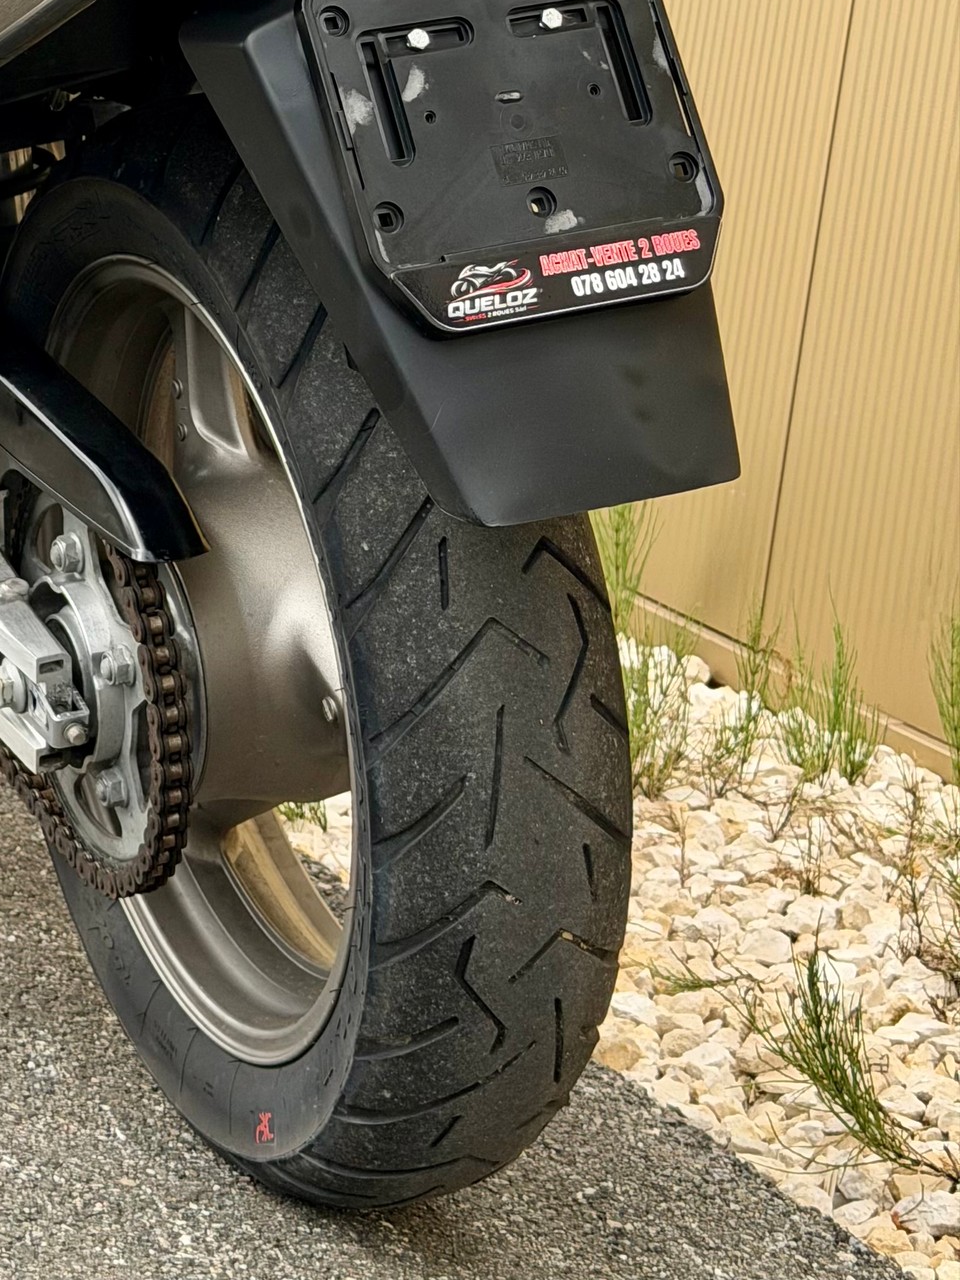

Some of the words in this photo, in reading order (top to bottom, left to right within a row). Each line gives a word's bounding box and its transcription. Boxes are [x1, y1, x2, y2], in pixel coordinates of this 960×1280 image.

[539, 239, 639, 277] ACHAT-VENTE
[637, 237, 652, 259] 2
[651, 228, 701, 256] ROUES
[570, 272, 604, 297] 078
[604, 266, 638, 291] 604
[638, 262, 661, 285] 28
[662, 258, 686, 281] 24
[447, 287, 538, 319] QUELOZ
